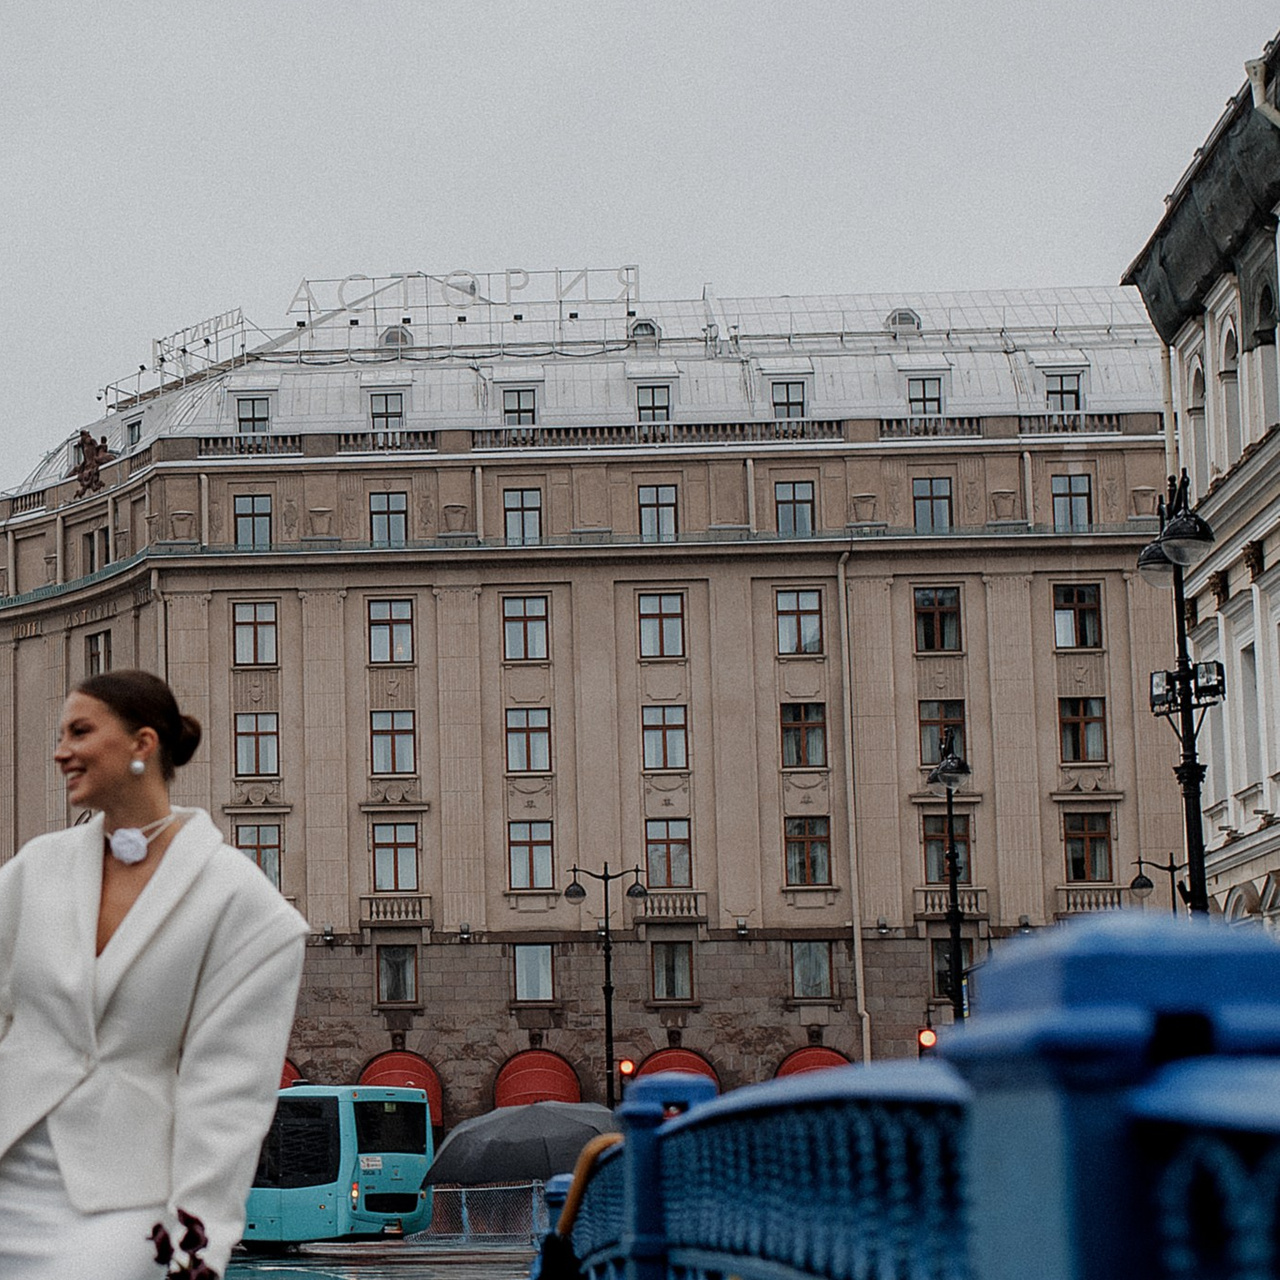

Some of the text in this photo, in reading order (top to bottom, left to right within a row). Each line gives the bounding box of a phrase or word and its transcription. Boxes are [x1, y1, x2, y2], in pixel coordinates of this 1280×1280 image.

[285, 264, 640, 315] АСТОРИЯ
[12, 621, 44, 638] HOTEL
[65, 601, 118, 628] ASTORIA
